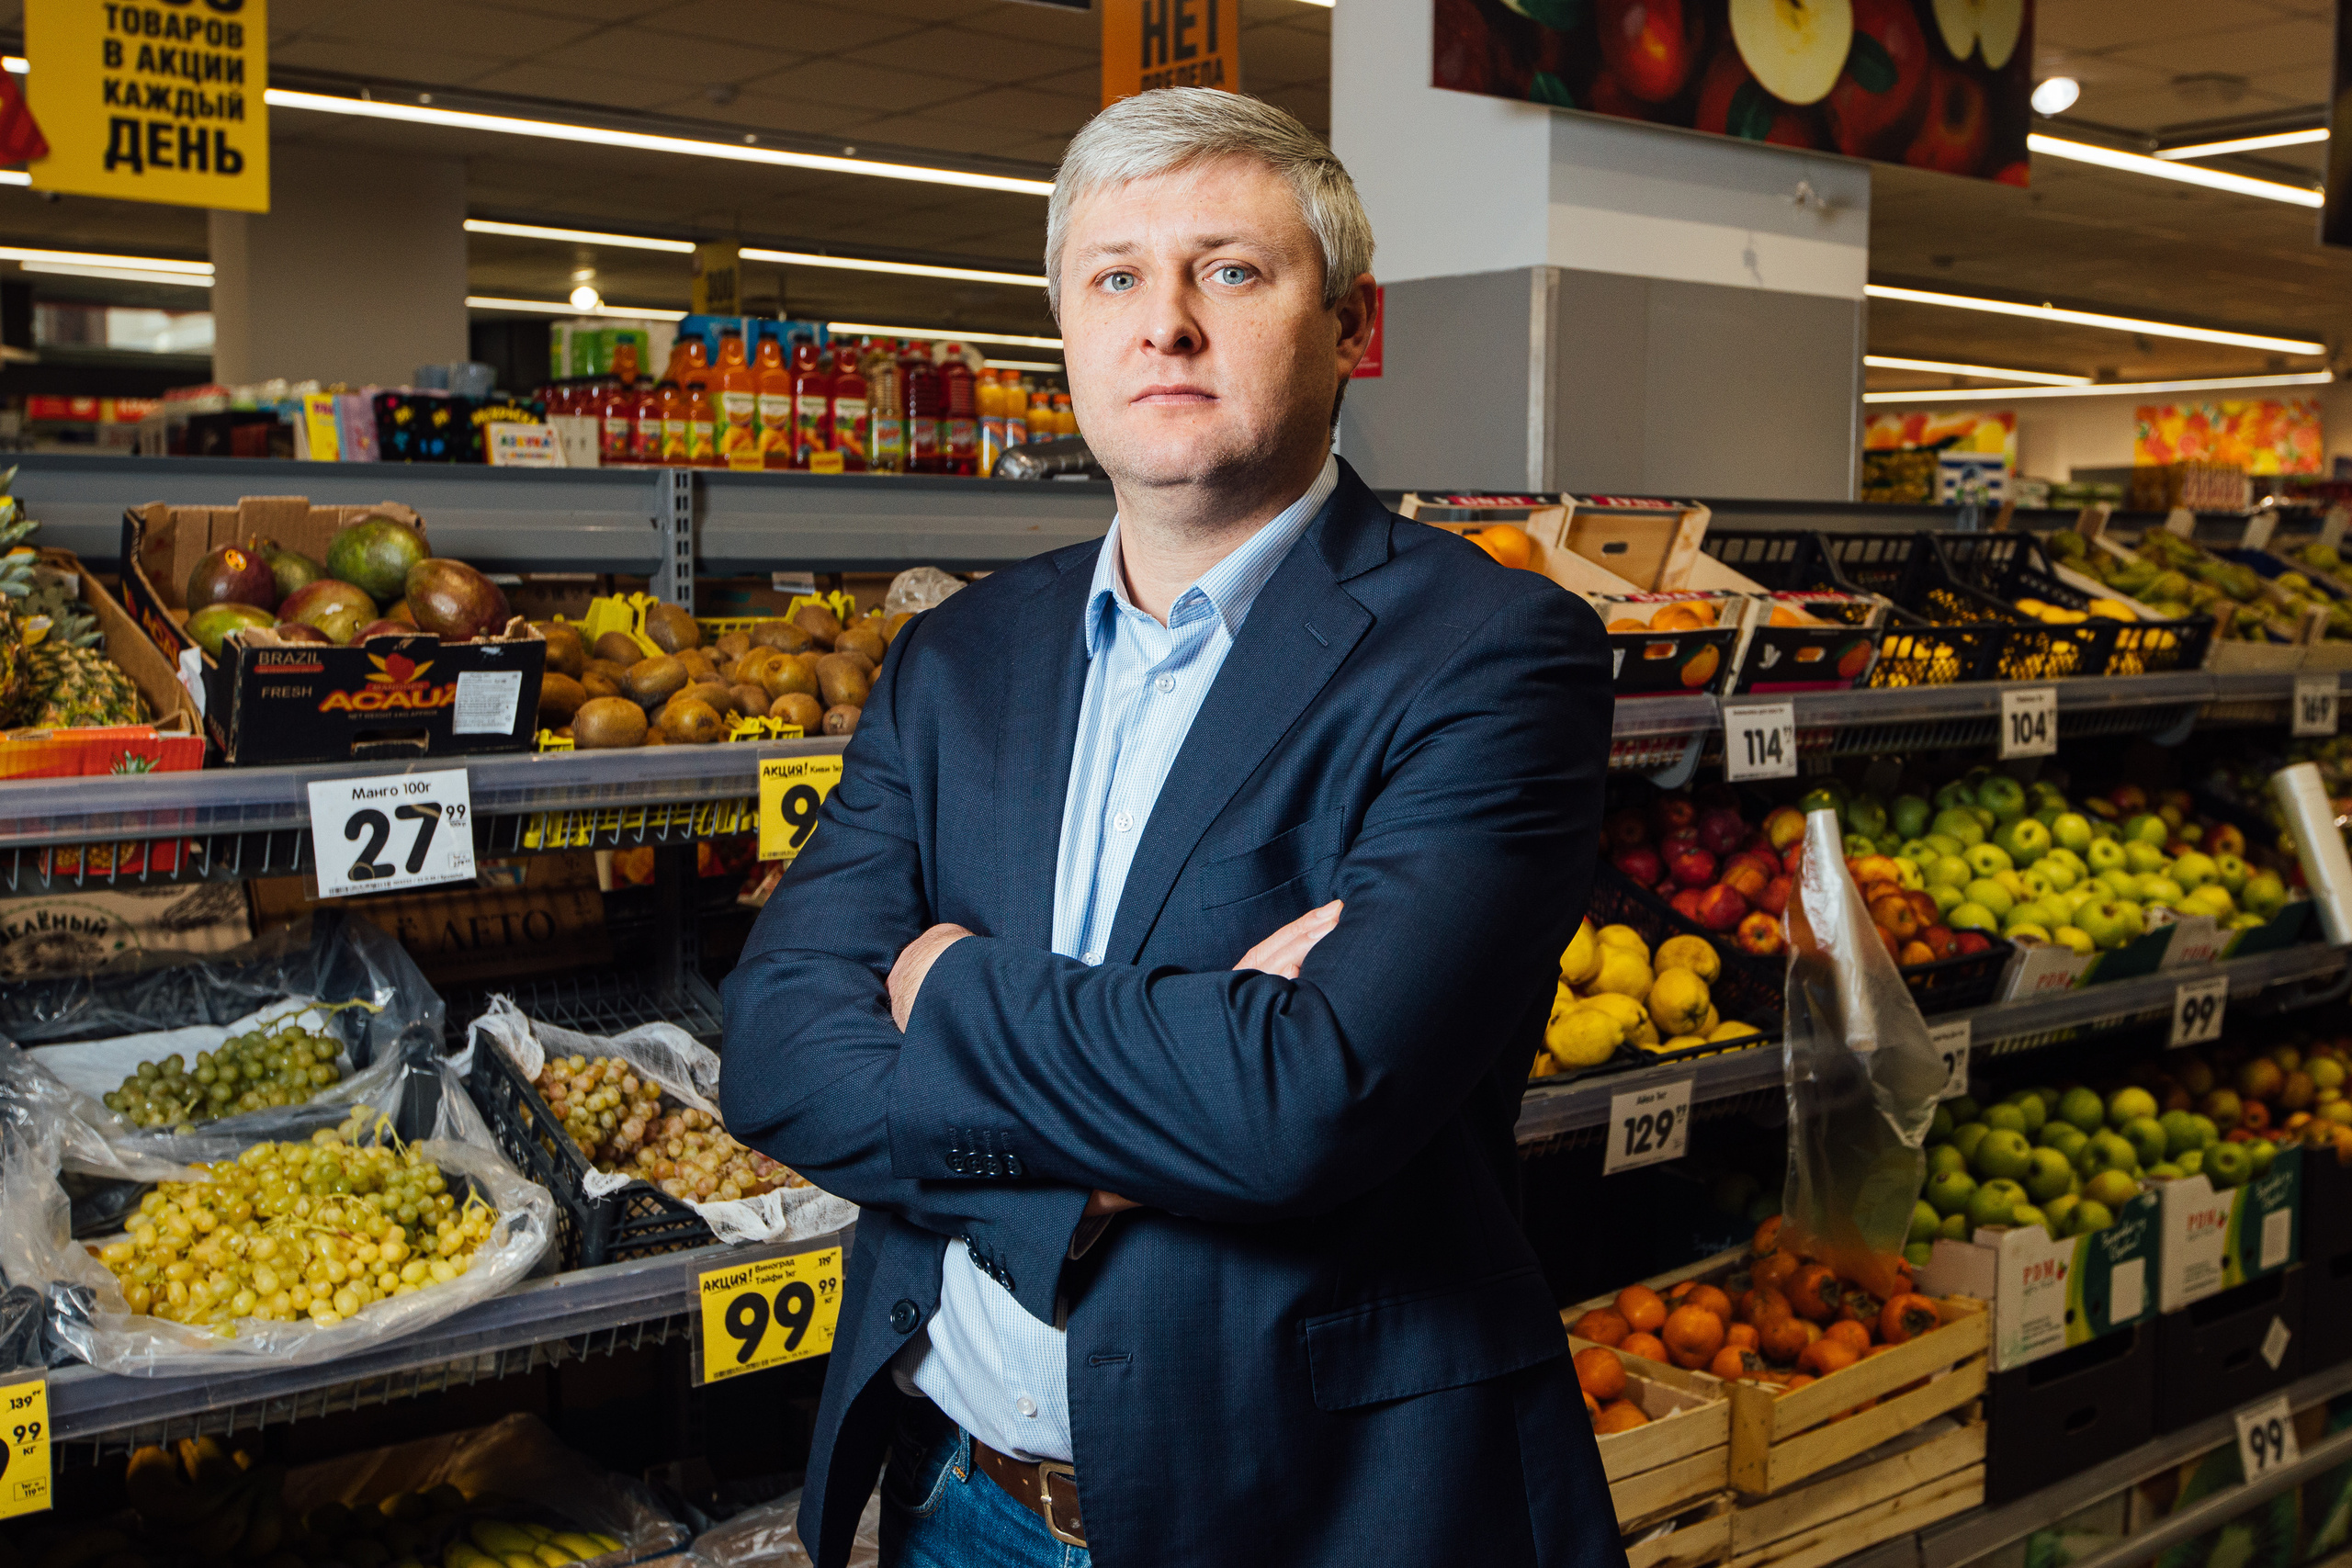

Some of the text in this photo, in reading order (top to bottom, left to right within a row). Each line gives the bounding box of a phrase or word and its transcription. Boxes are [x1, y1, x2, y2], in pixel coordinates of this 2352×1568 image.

[104, 2, 244, 51] ТОВАРОВ
[104, 37, 244, 85] В АКЦИИ
[103, 77, 244, 122] КАЖДЫЙ
[104, 116, 244, 175] ДЕНЬ
[258, 650, 322, 666] BRAZIL
[261, 686, 313, 699] FRESH
[1744, 728, 1783, 766] 114
[2011, 712, 2046, 744] 104
[763, 762, 808, 778] АКЦИЯ!
[352, 782, 432, 801] Манго 100г
[345, 802, 467, 882] 27 99
[441, 909, 556, 953] ЛЕТО
[2183, 995, 2214, 1037] 99
[1624, 1109, 1674, 1156] 129
[703, 1259, 796, 1294] АКЦИЯ! Виноград
[756, 1273, 784, 1285] Тайфи
[725, 1281, 815, 1364] 99
[819, 1277, 837, 1295] 99
[10, 1395, 32, 1410] 139
[13, 1421, 41, 1444] 99
[23, 1446, 36, 1456] кг
[2251, 1418, 2282, 1469] 99
